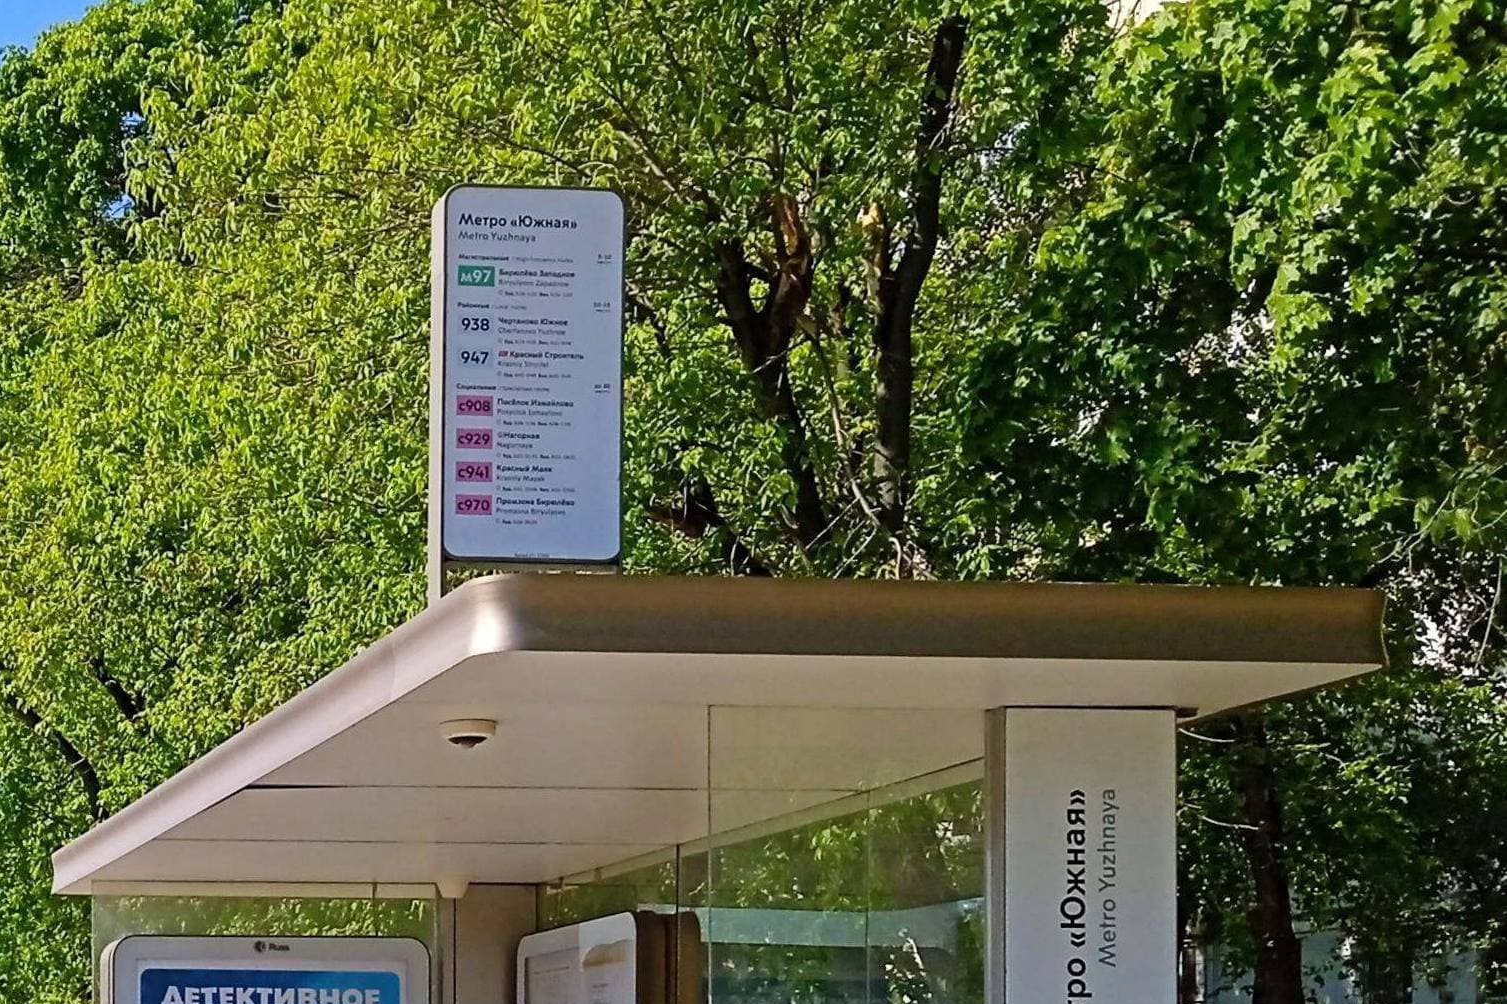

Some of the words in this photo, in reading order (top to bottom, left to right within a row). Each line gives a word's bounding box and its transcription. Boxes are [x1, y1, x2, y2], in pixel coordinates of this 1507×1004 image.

[458, 213, 507, 229] Метро
[510, 215, 578, 230] «Южная»
[458, 231, 488, 241] Metro
[491, 232, 536, 243] Yuzhnaya
[461, 318, 490, 331] 938
[461, 351, 489, 364] 947
[1096, 787, 1120, 893] Yuzhnaya
[1059, 788, 1087, 949] «Южная»
[1098, 898, 1117, 968] Metro
